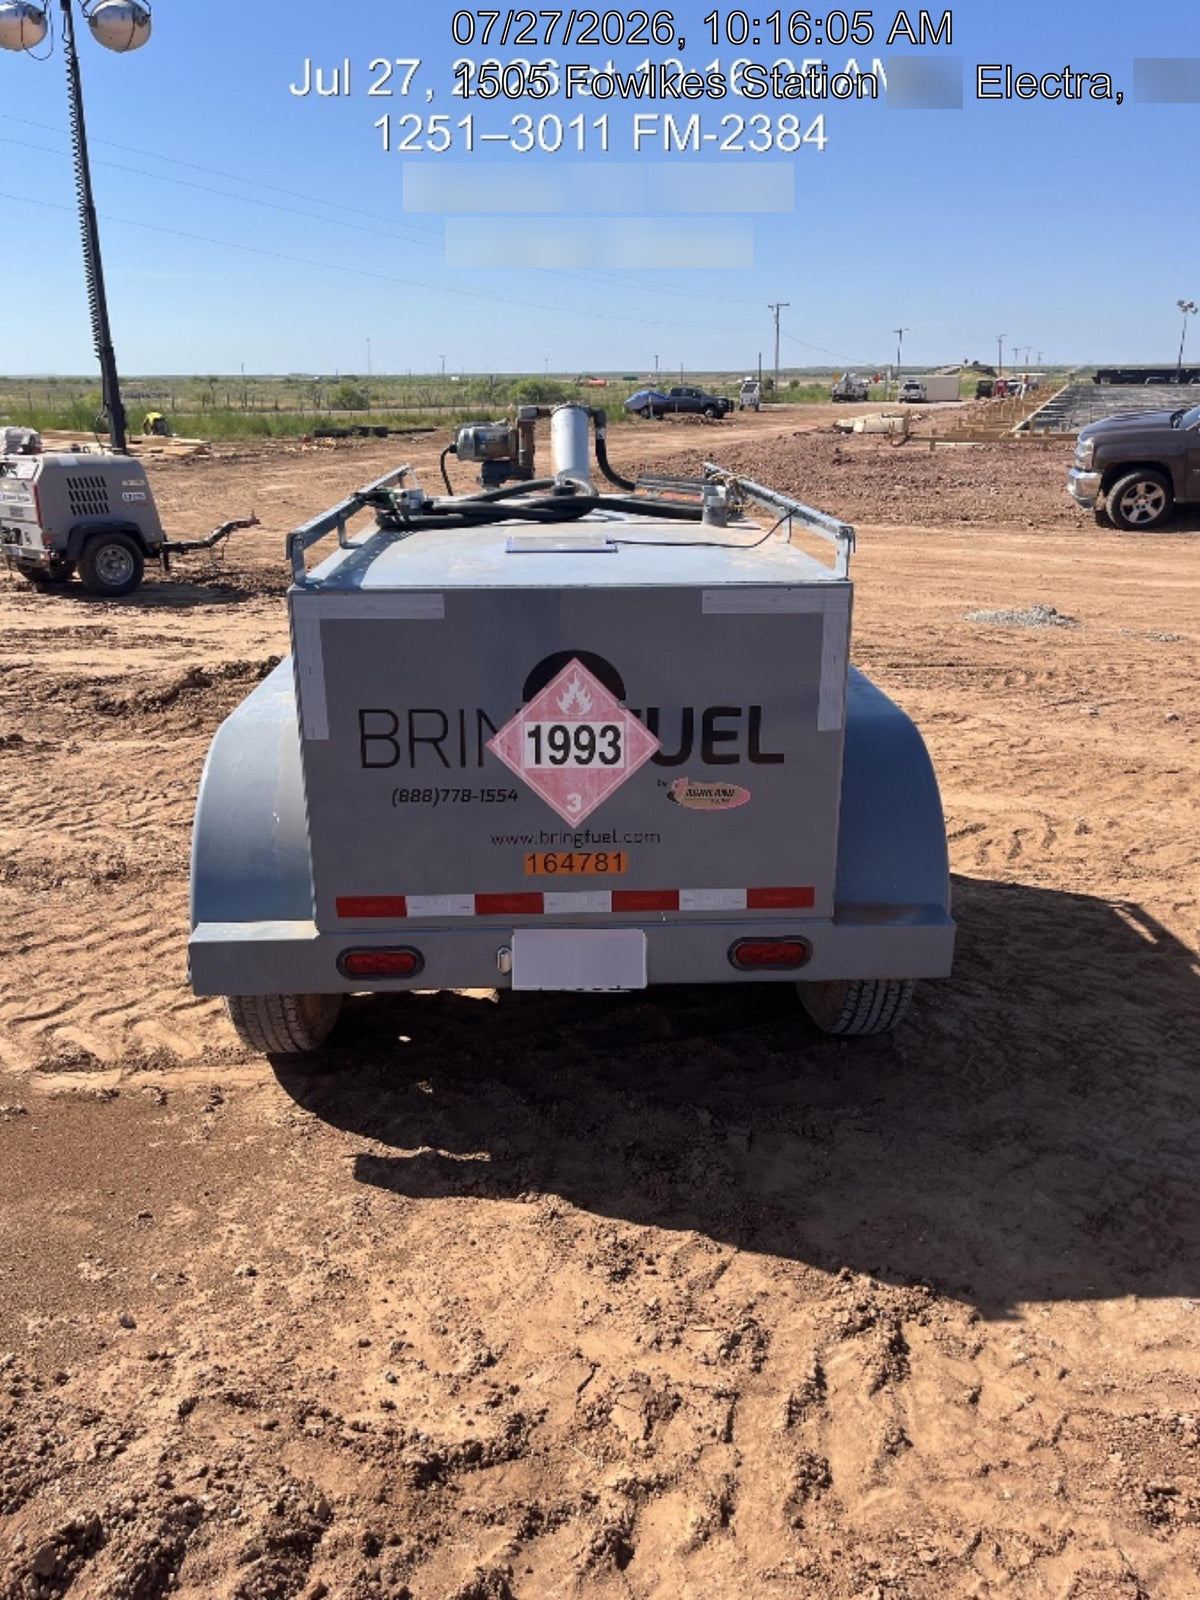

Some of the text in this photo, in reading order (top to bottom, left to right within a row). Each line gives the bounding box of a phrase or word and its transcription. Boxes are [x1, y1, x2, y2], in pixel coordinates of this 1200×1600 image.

[526, 724, 622, 766] 1993
[392, 786, 519, 808] (888)778-1554
[565, 792, 583, 814] 3
[489, 828, 662, 849] www.bringfuel.com
[526, 851, 623, 874] 164781
